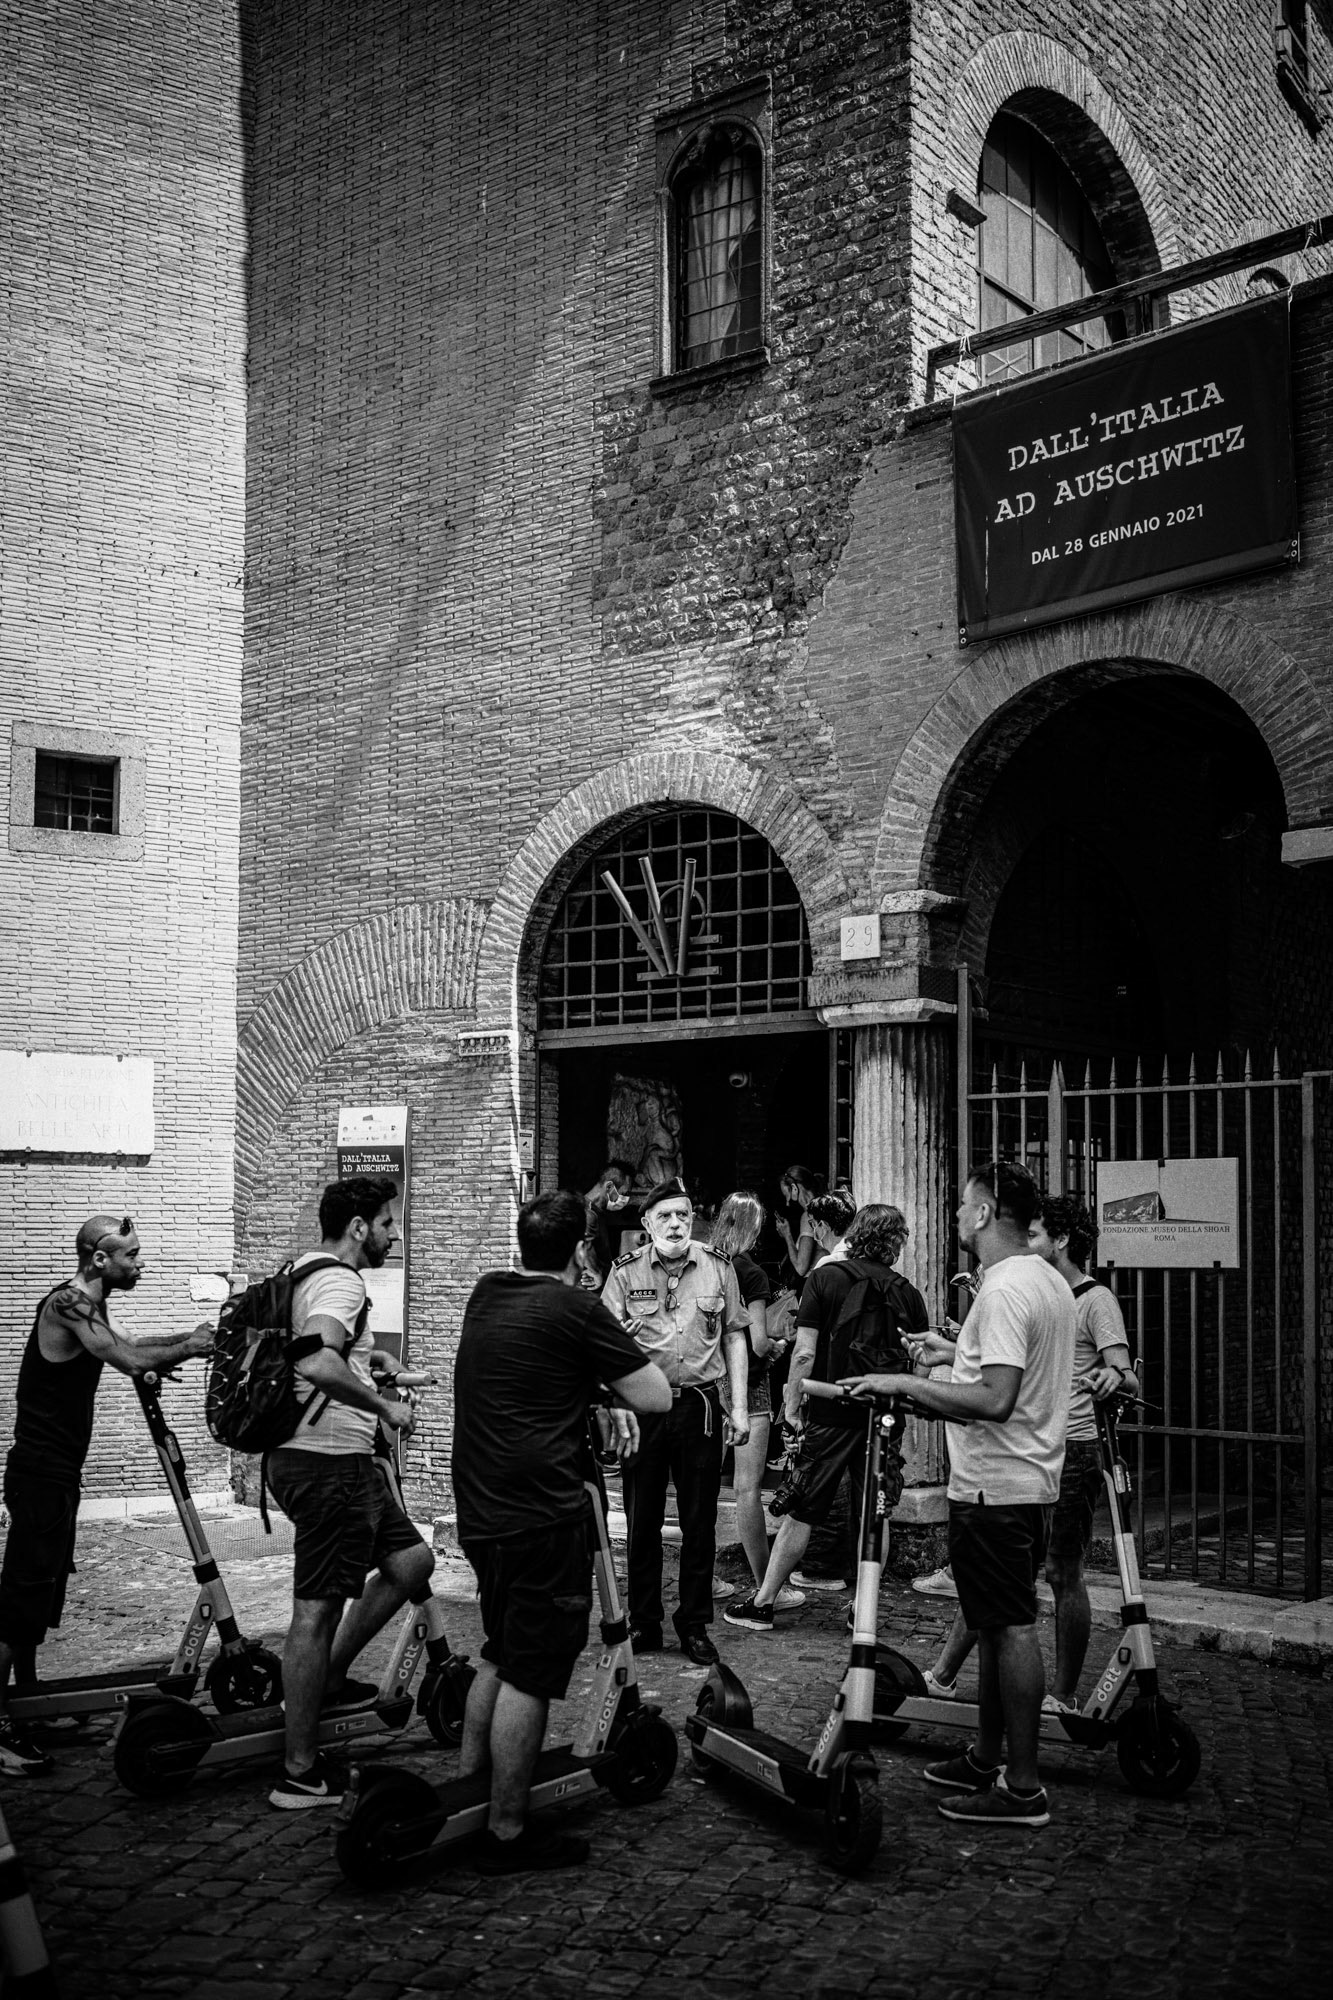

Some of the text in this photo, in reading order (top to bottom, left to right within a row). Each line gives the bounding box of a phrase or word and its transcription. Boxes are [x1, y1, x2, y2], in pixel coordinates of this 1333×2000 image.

[1008, 382, 1225, 471] DALL'ITALIA
[994, 424, 1246, 523] AD AUSCHWITZ
[1031, 503, 1205, 565] DAL 28 GENNAIO 2021
[845, 925, 873, 948] 29
[341, 1152, 391, 1163] DALL'ITALIA
[342, 1163, 400, 1173] AD AUSCHWITZ
[1103, 1226, 1149, 1234] FONDAZIONE
[1204, 1225, 1230, 1233] SHOAH
[184, 1623, 206, 1657] dott
[398, 1643, 420, 1680] dott
[1096, 1666, 1122, 1703] dott
[598, 1690, 619, 1733] dott
